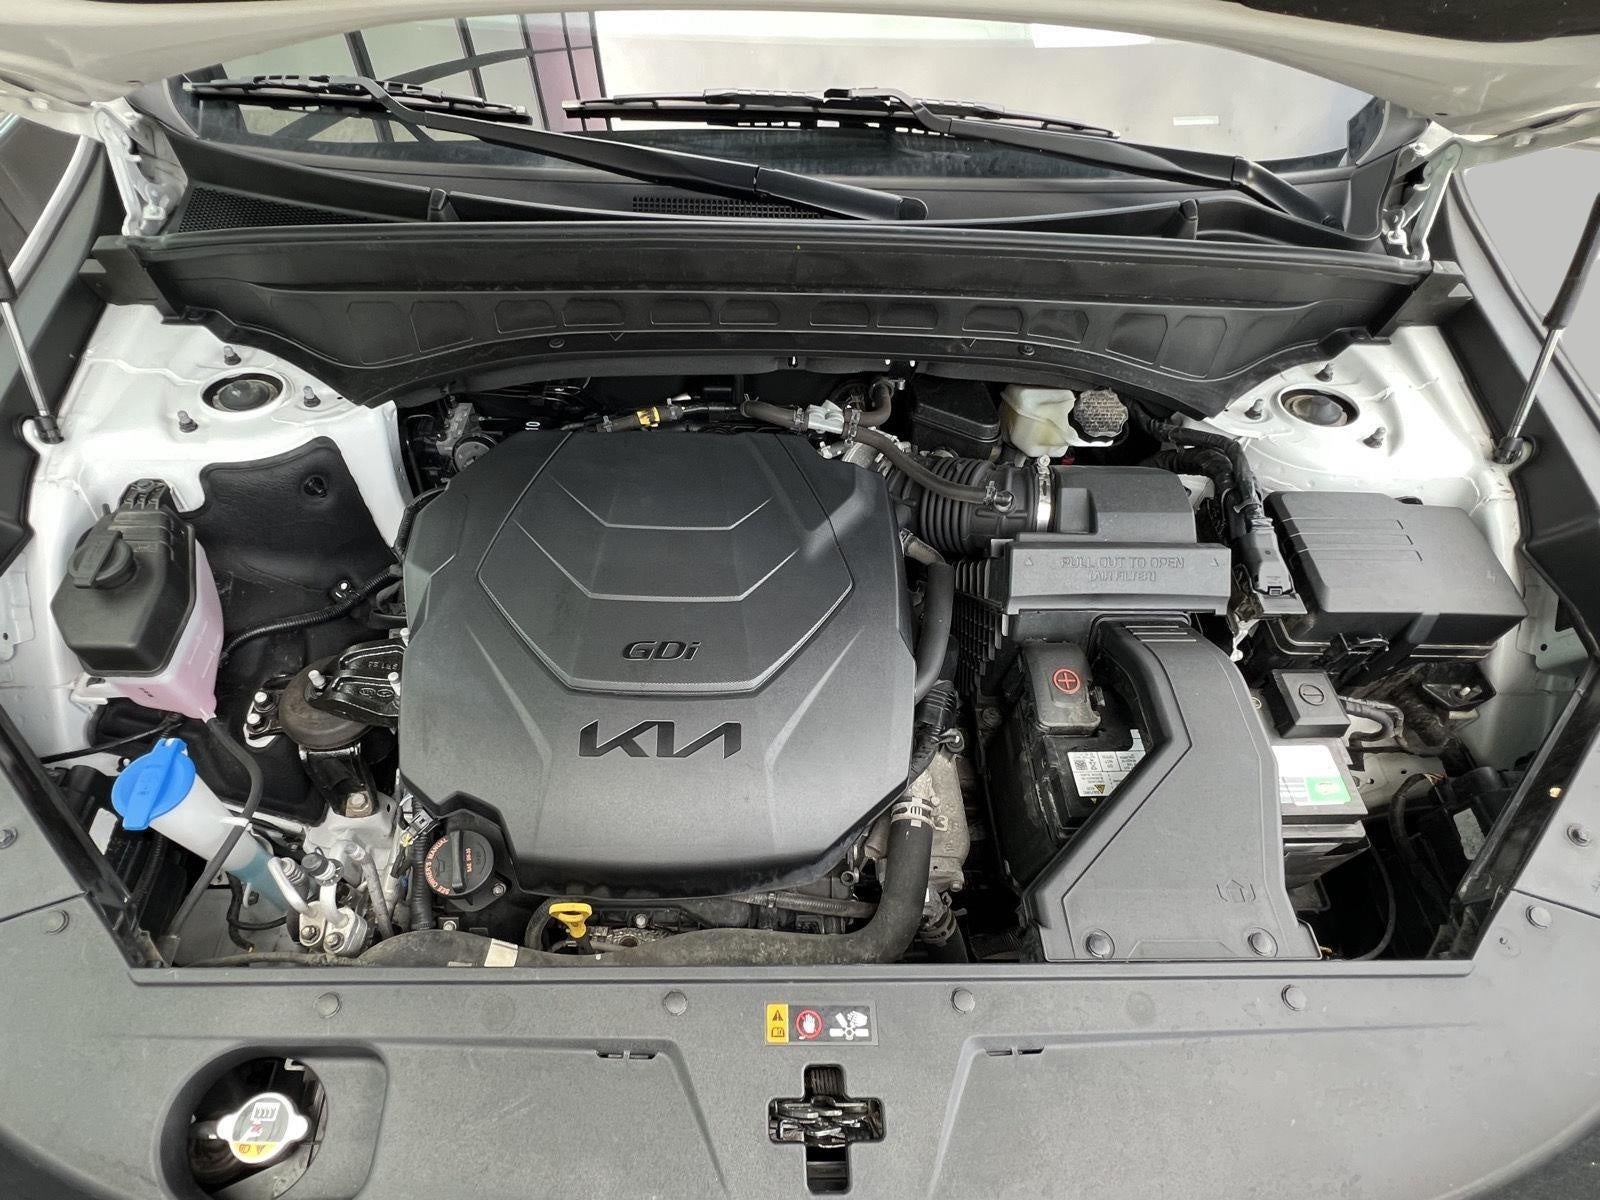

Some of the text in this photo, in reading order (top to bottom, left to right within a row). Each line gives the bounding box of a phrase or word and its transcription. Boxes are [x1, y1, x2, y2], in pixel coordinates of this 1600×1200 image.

[1061, 556, 1185, 569] PULL OUT TO OPEN
[622, 641, 702, 661] GDi
[578, 719, 742, 760] KIA
[425, 837, 450, 895] SEE OWNER'S MANUAL
